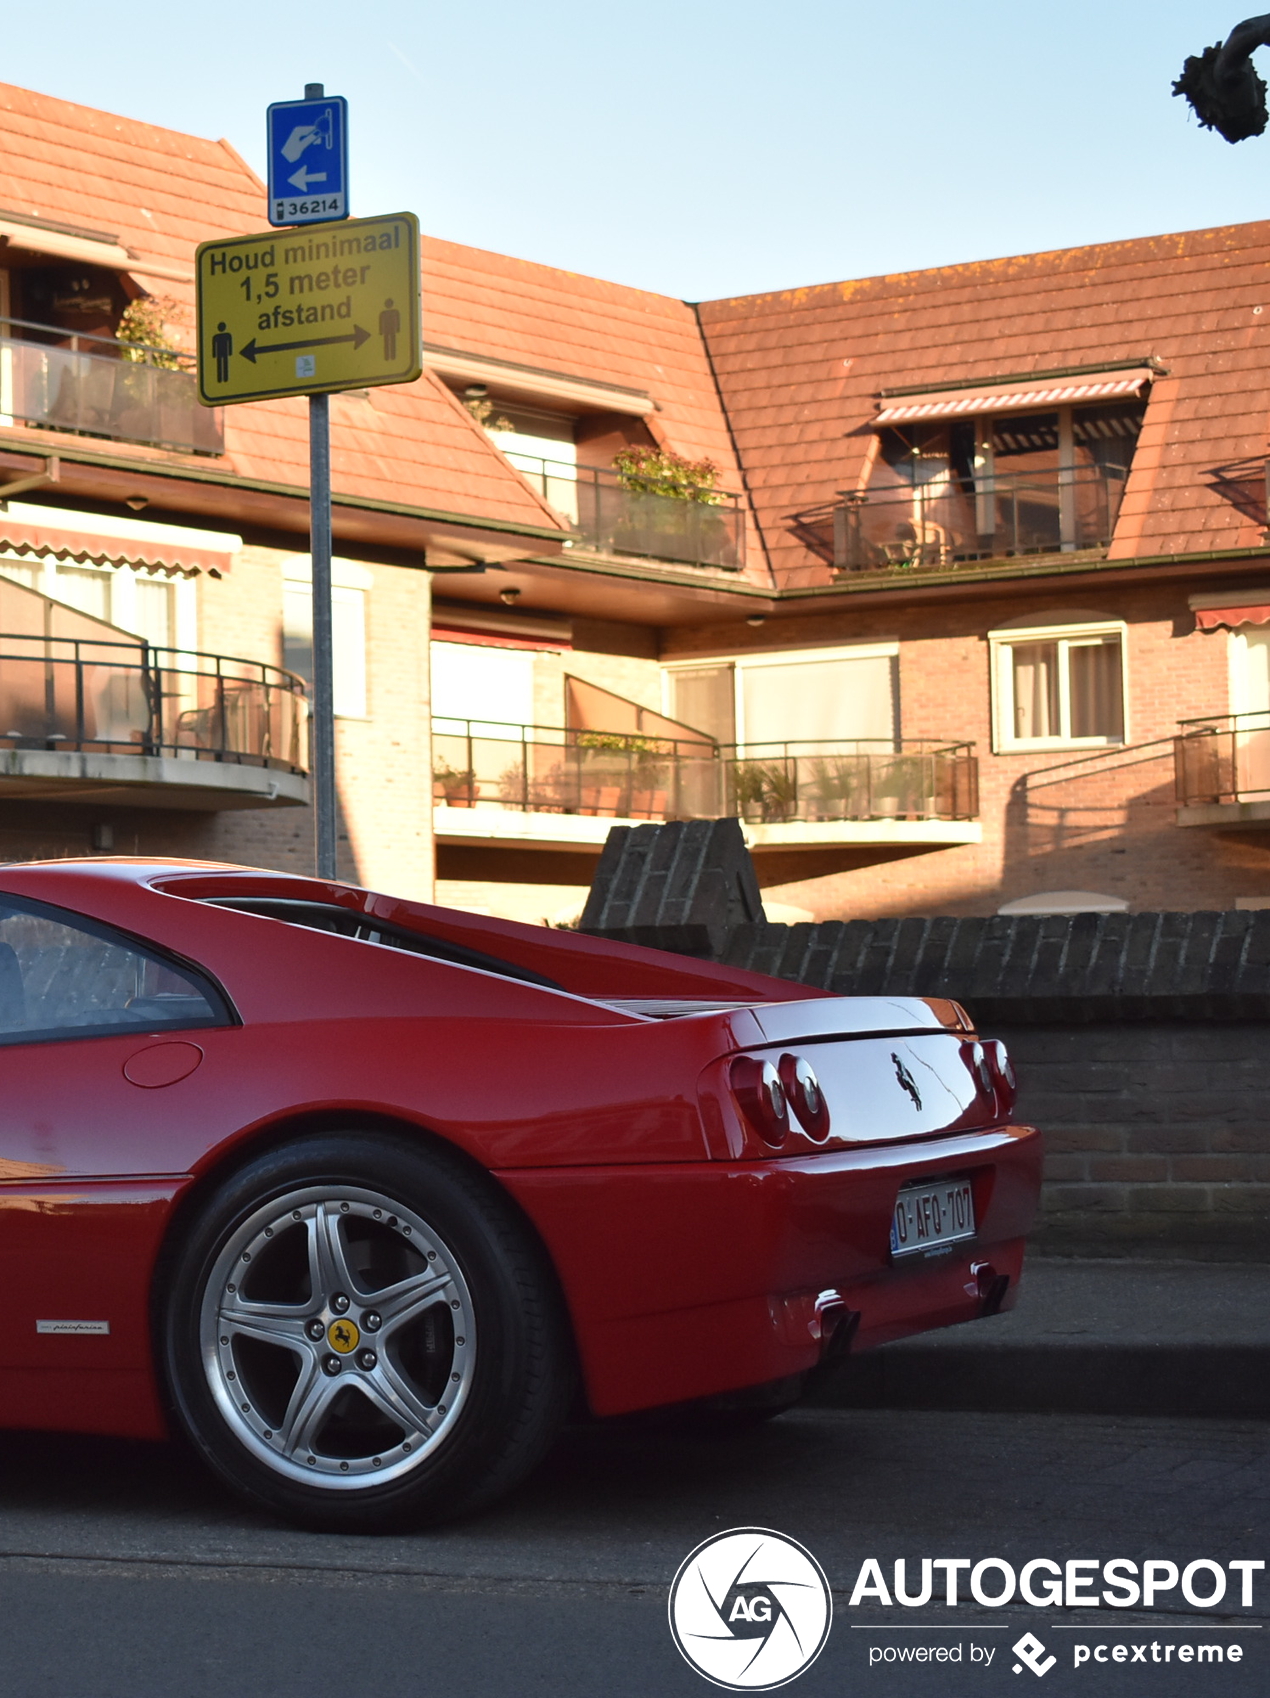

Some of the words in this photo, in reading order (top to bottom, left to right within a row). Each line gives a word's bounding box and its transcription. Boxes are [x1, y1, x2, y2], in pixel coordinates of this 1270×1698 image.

[288, 198, 340, 216] 36214
[210, 244, 276, 276] Houd
[284, 226, 400, 265] minimaal
[240, 272, 279, 305] 1,5
[289, 263, 371, 295] meter
[257, 295, 352, 332] afstand
